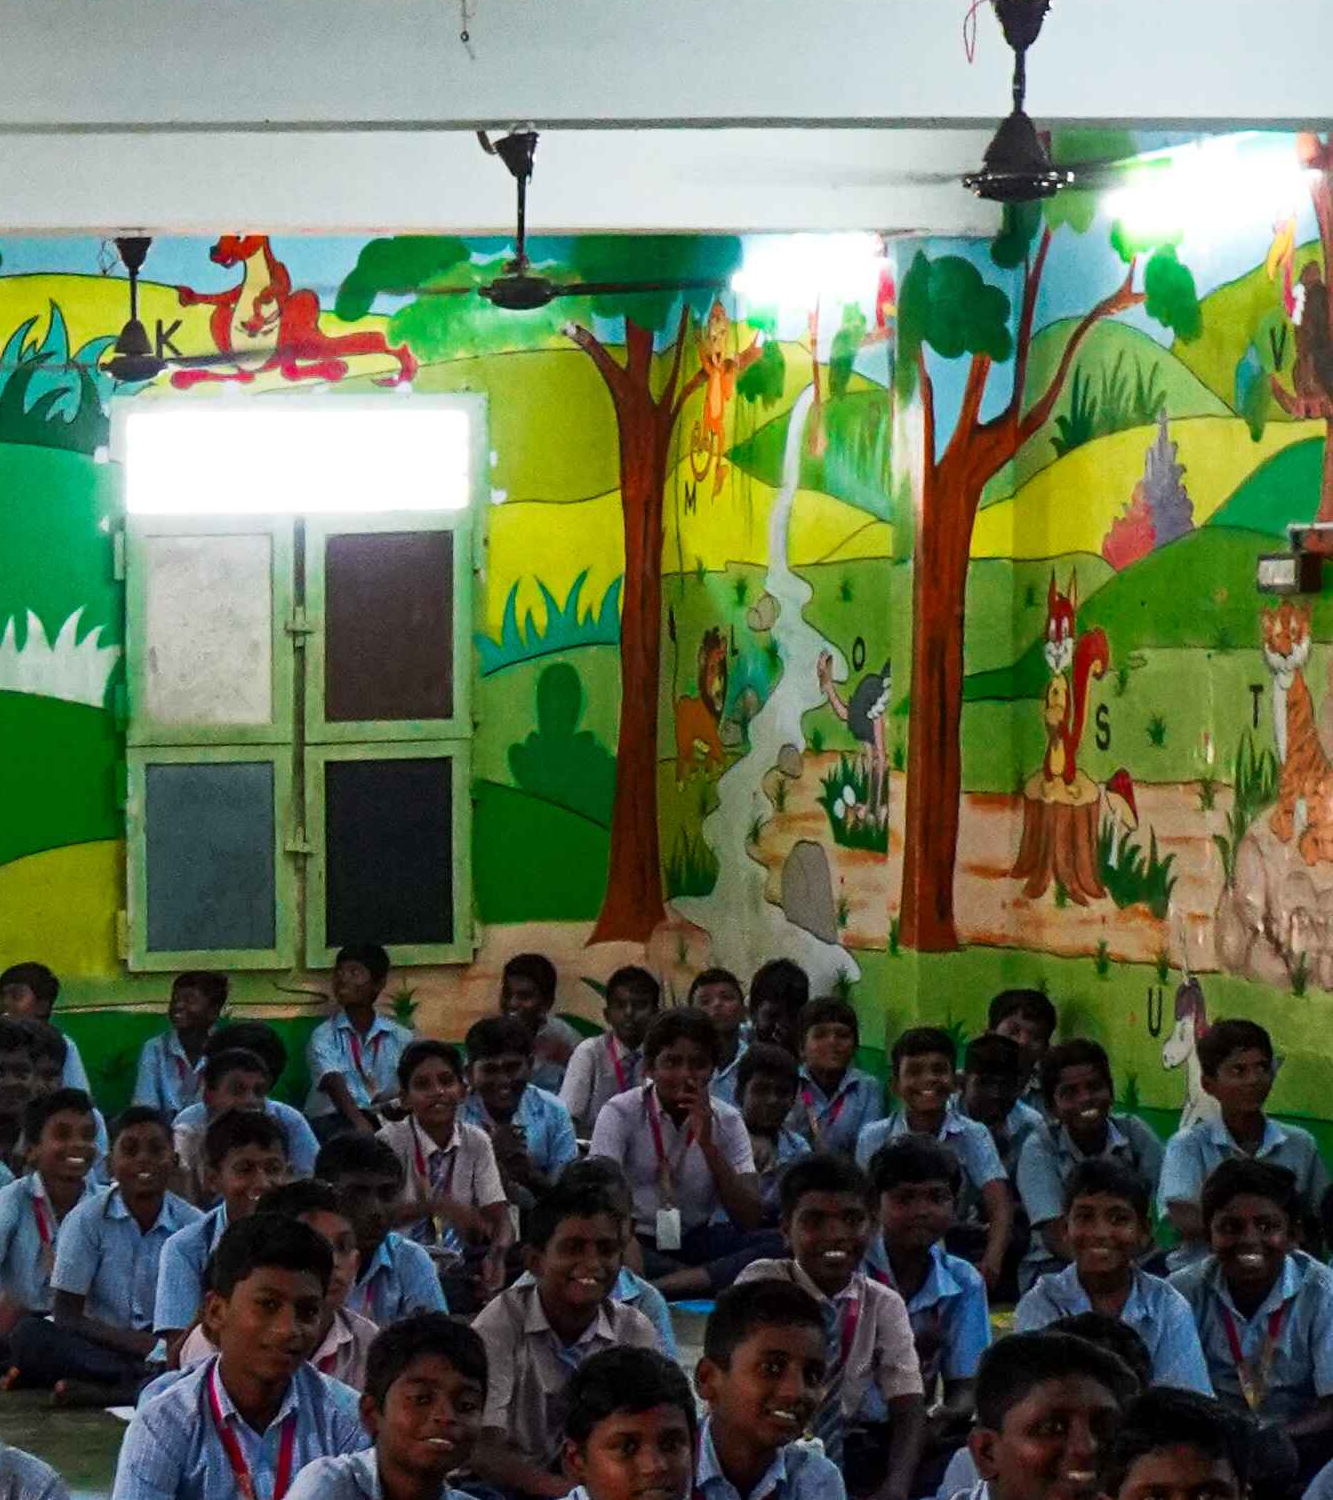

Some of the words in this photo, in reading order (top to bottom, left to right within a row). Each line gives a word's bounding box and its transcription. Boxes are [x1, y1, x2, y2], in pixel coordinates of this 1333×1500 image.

[155, 319, 183, 359] K
[1269, 323, 1288, 373] V
[684, 480, 697, 517] M
[851, 636, 866, 673] O
[1095, 702, 1112, 752] S
[1248, 684, 1265, 729] T
[1147, 986, 1163, 1038] U
